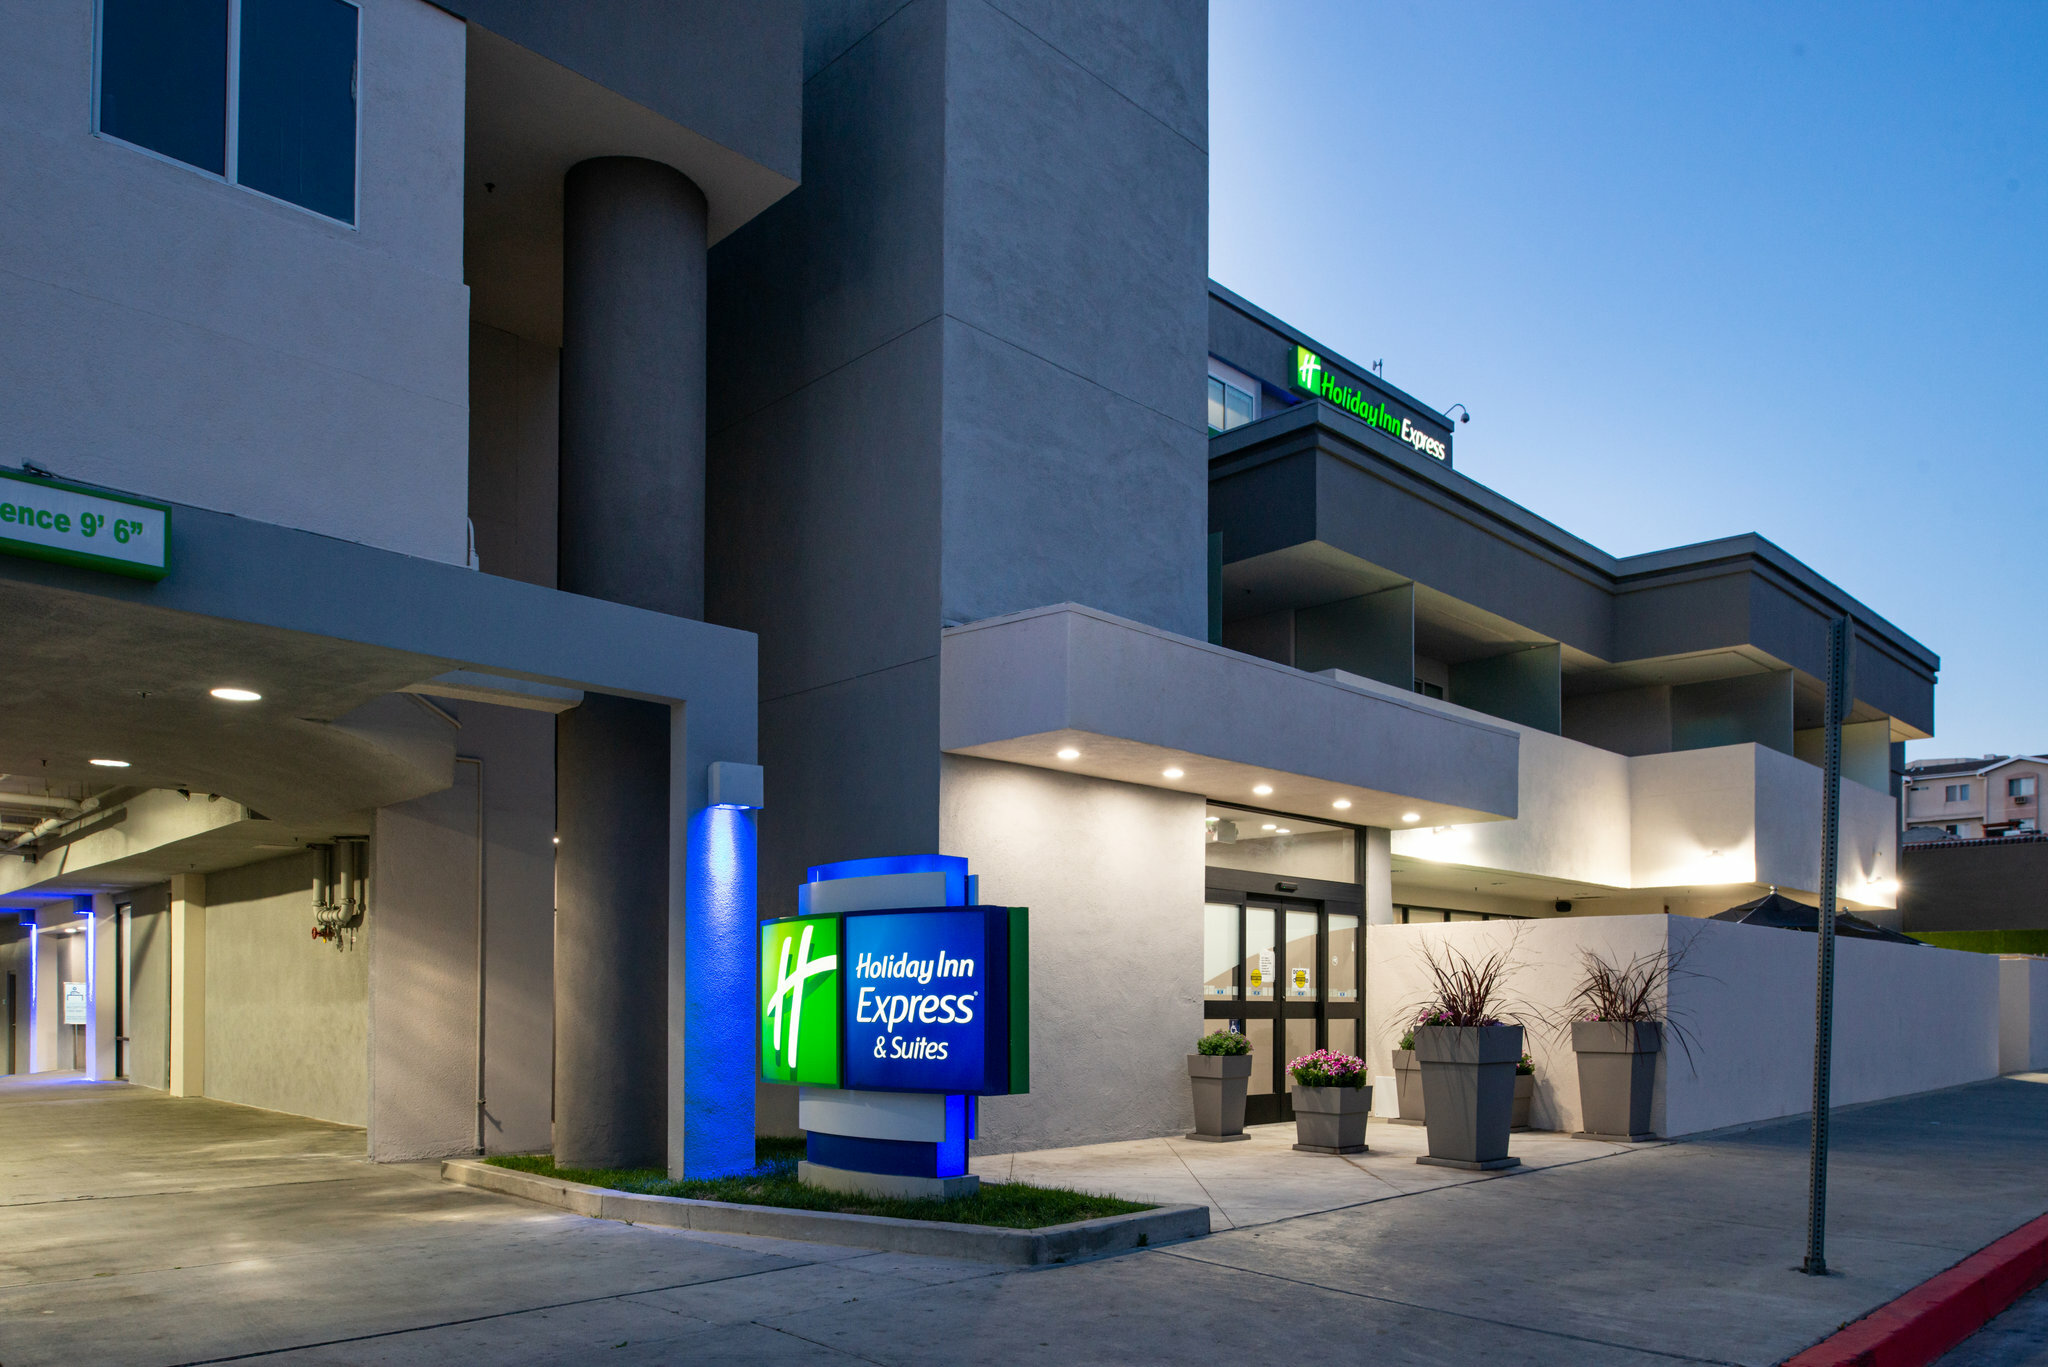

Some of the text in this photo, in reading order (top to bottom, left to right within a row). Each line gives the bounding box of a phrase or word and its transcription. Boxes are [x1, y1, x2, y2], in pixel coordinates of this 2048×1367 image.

[1321, 370, 1379, 428] Holiday
[1401, 417, 1446, 461] Express
[0, 502, 71, 533] ence
[855, 950, 975, 985] Holiday Inn
[856, 986, 975, 1034] Express
[873, 1035, 949, 1060] & Suites
